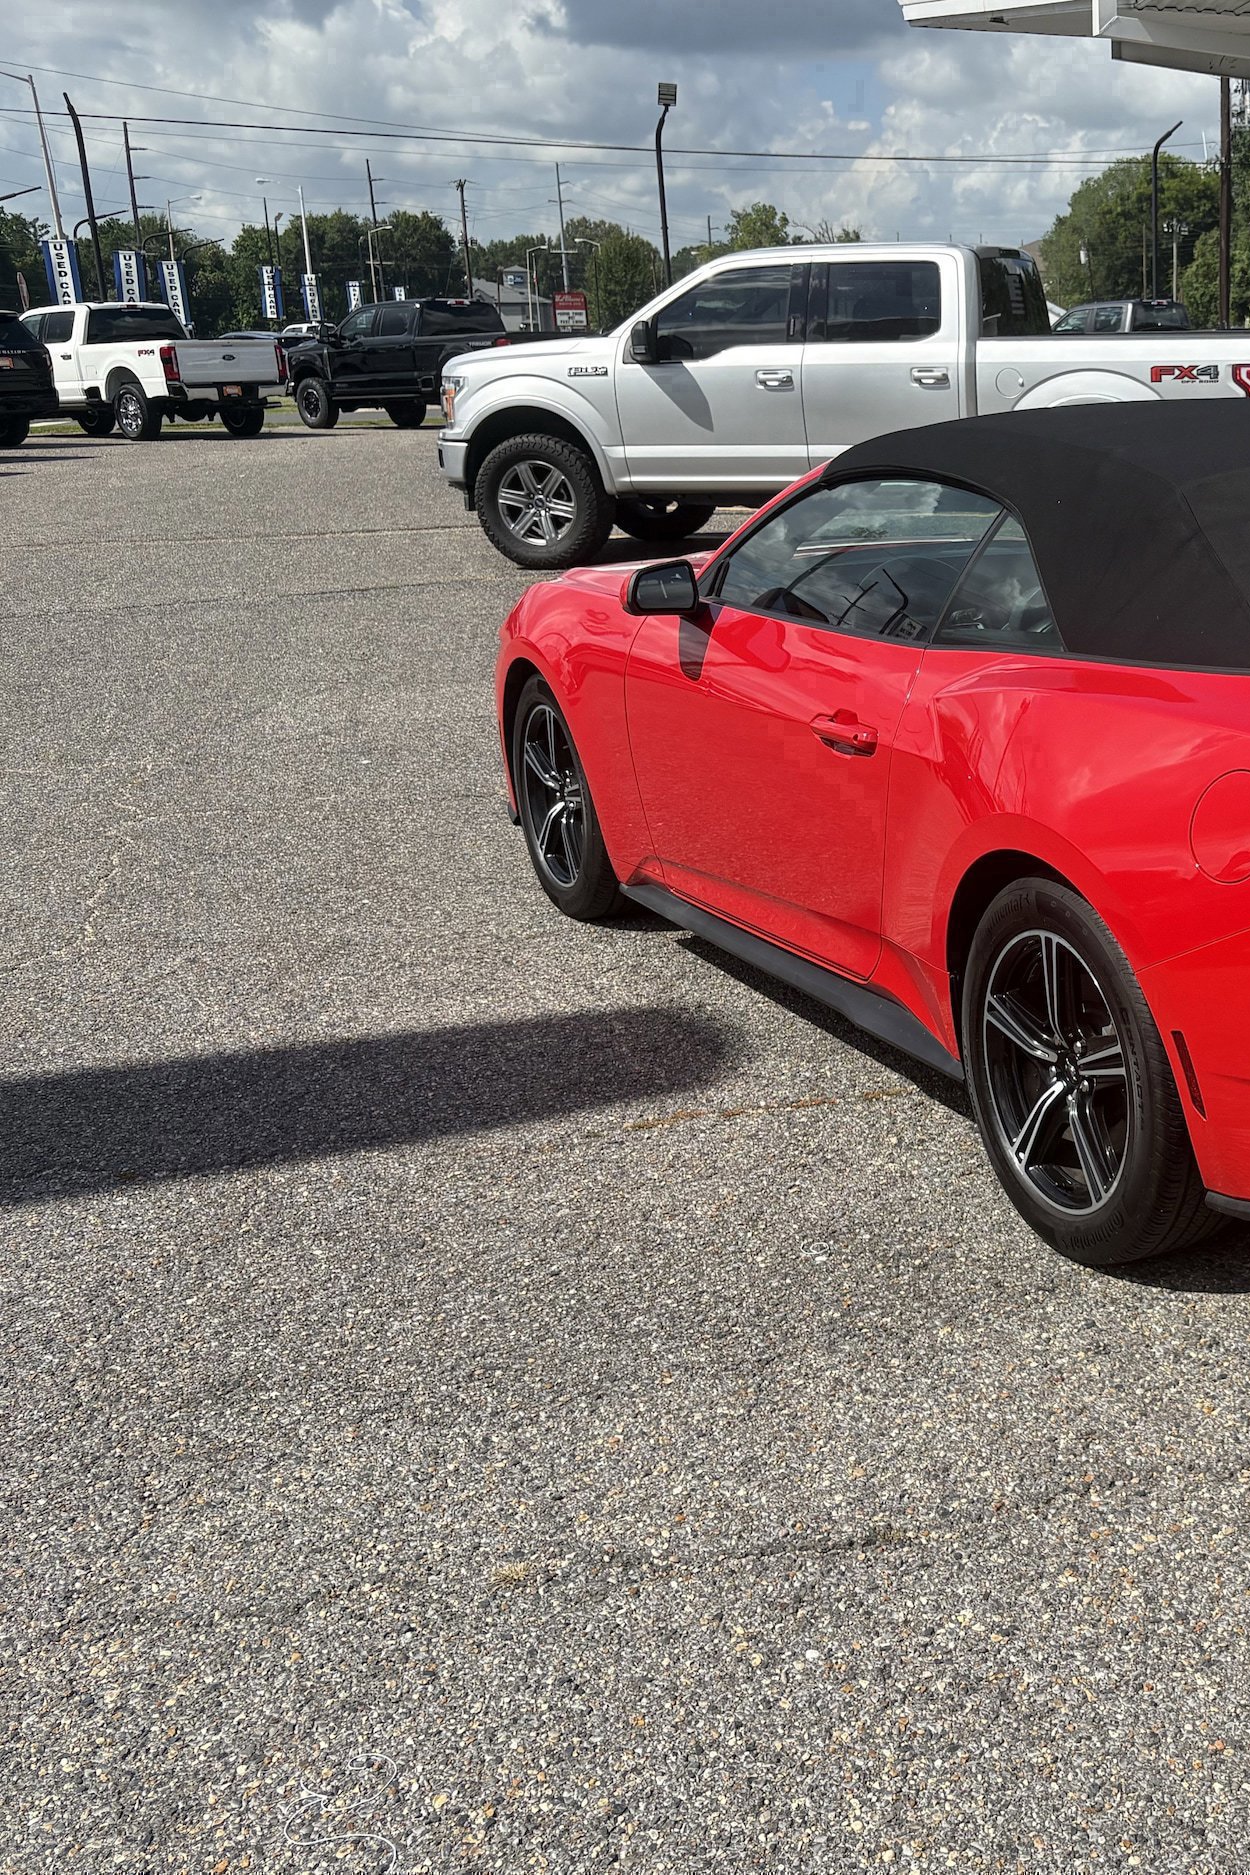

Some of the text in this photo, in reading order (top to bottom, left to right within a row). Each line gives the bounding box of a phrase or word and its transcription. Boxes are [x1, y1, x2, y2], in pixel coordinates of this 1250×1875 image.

[53, 243, 72, 305] USED CAR
[123, 255, 136, 302] USED CA
[166, 264, 182, 320] USED CAR
[1151, 365, 1219, 383] FX4
